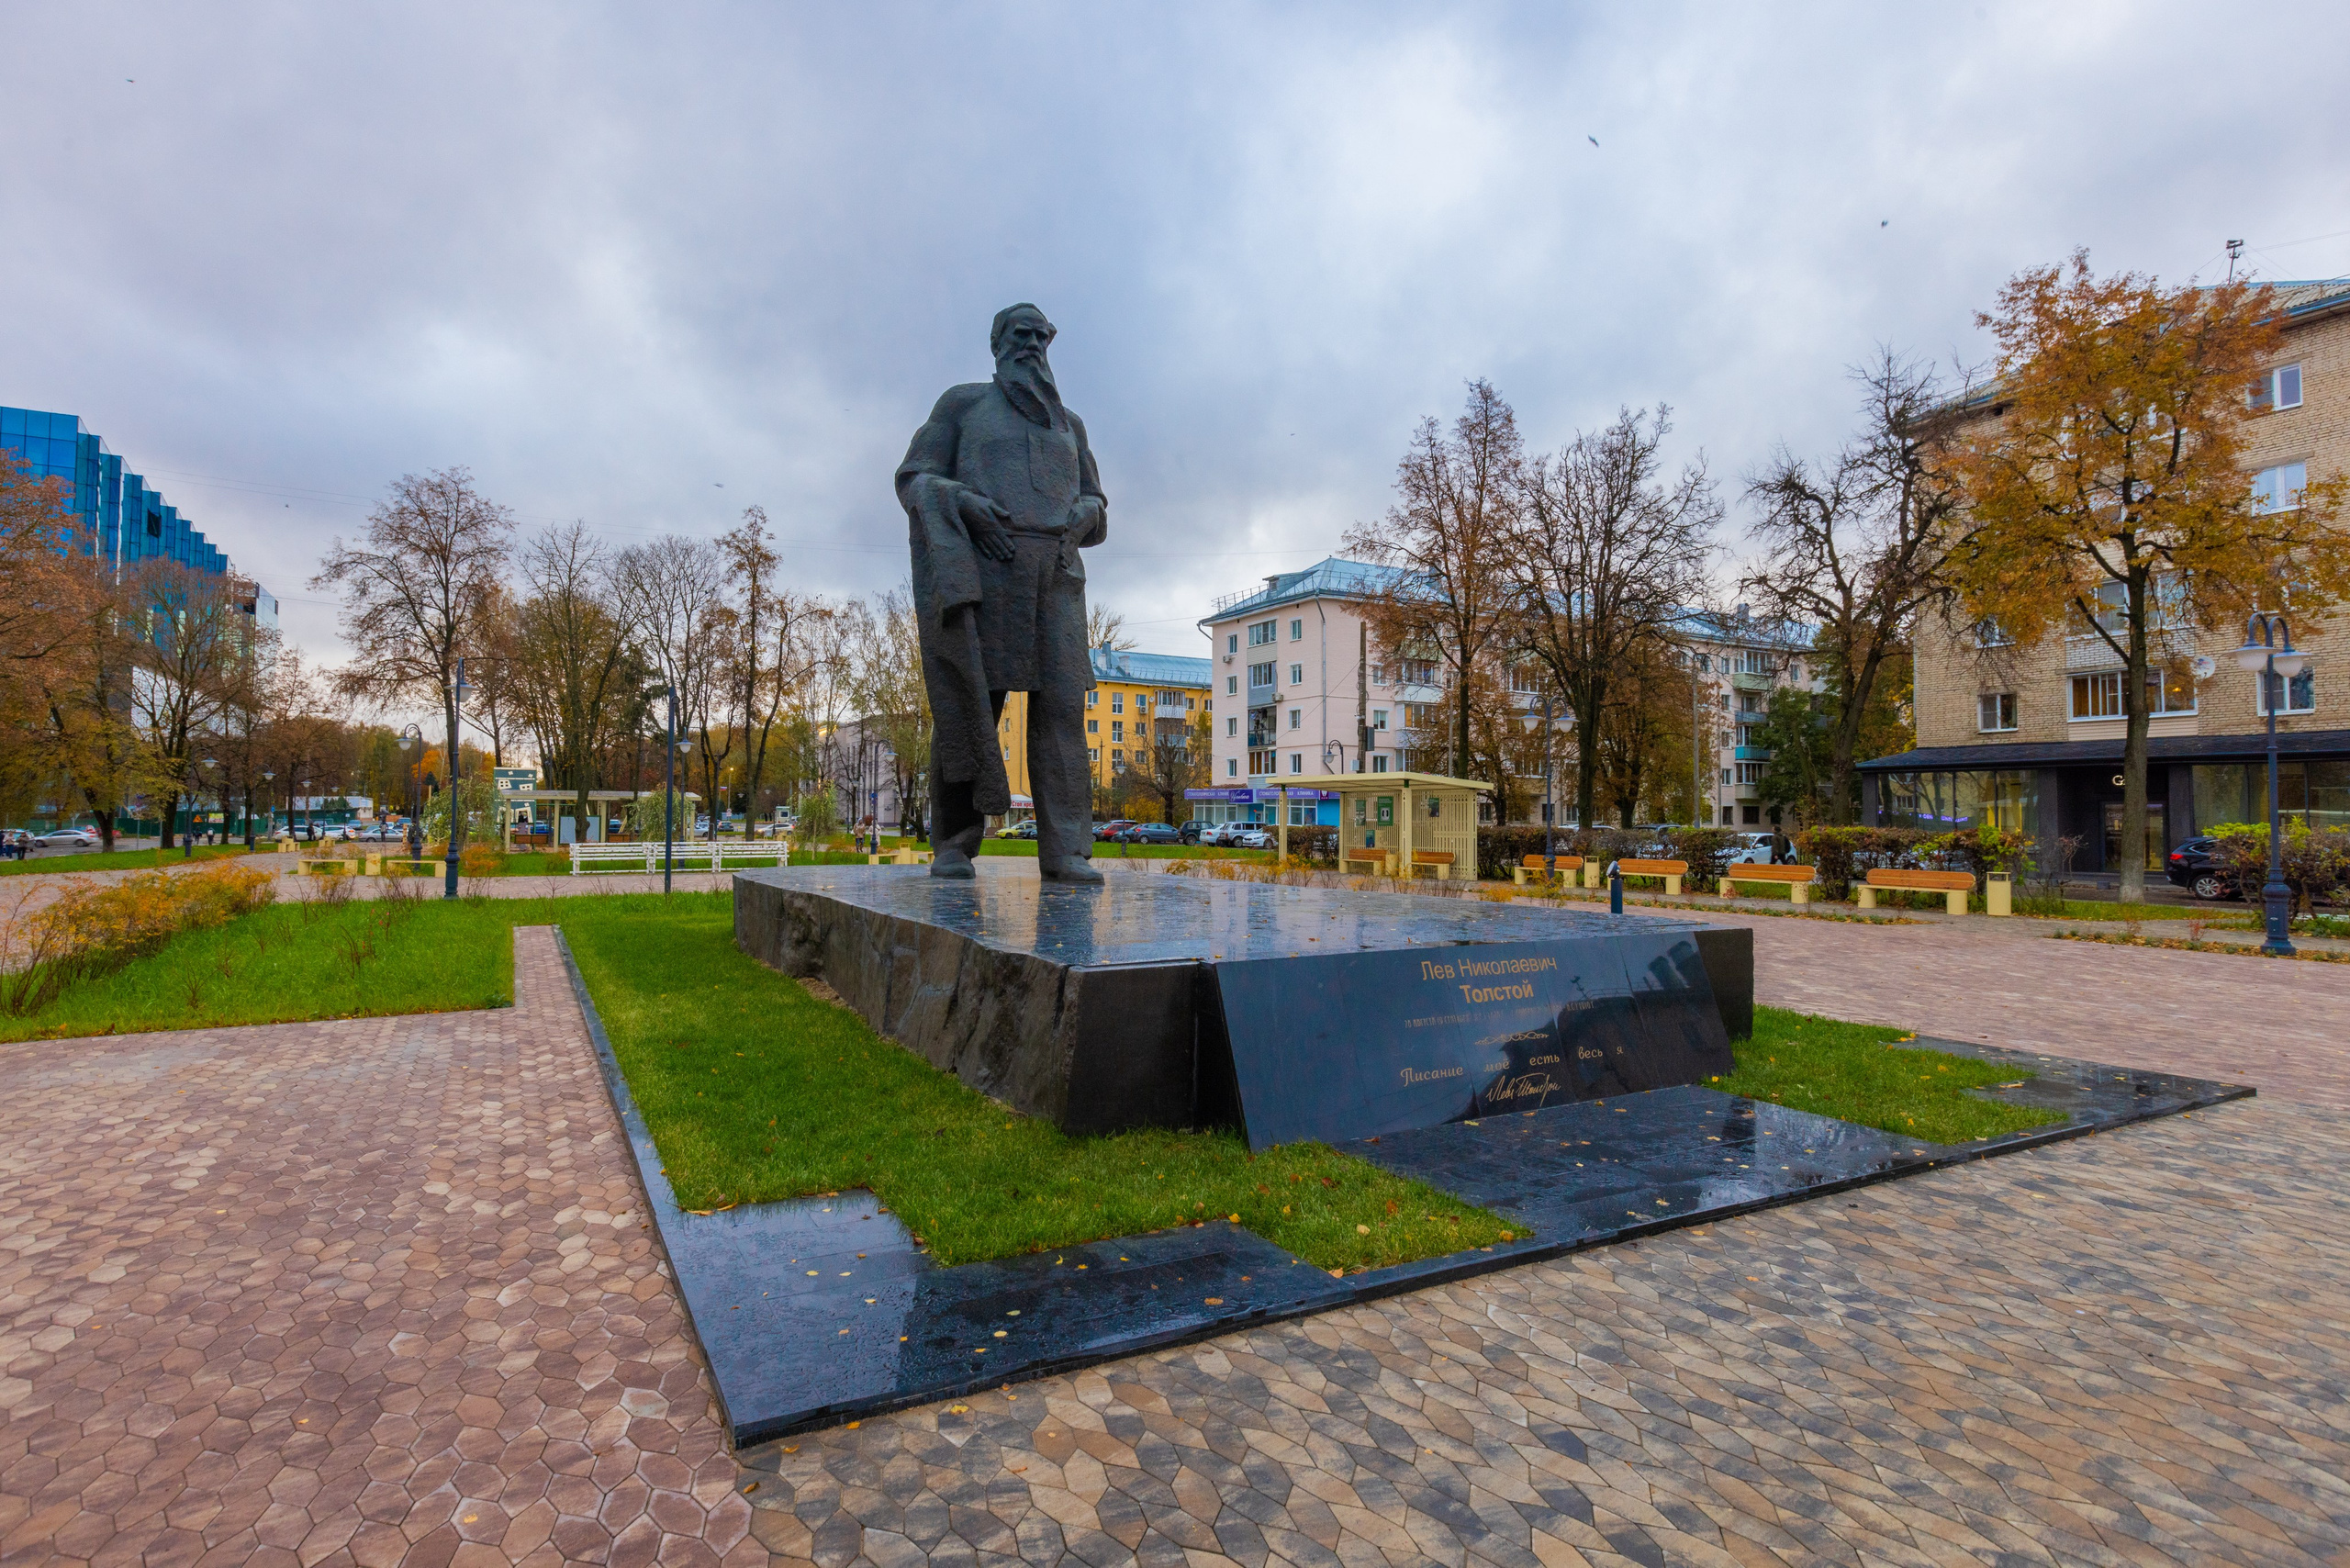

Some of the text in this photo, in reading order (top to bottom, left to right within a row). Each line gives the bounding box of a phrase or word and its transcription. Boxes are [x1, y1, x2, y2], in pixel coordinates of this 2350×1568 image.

[1420, 957, 1558, 980] Лев Николаевич
[1459, 979, 1535, 1003] Толстой
[1400, 1046, 1623, 1087] Писание моё есть весь я
